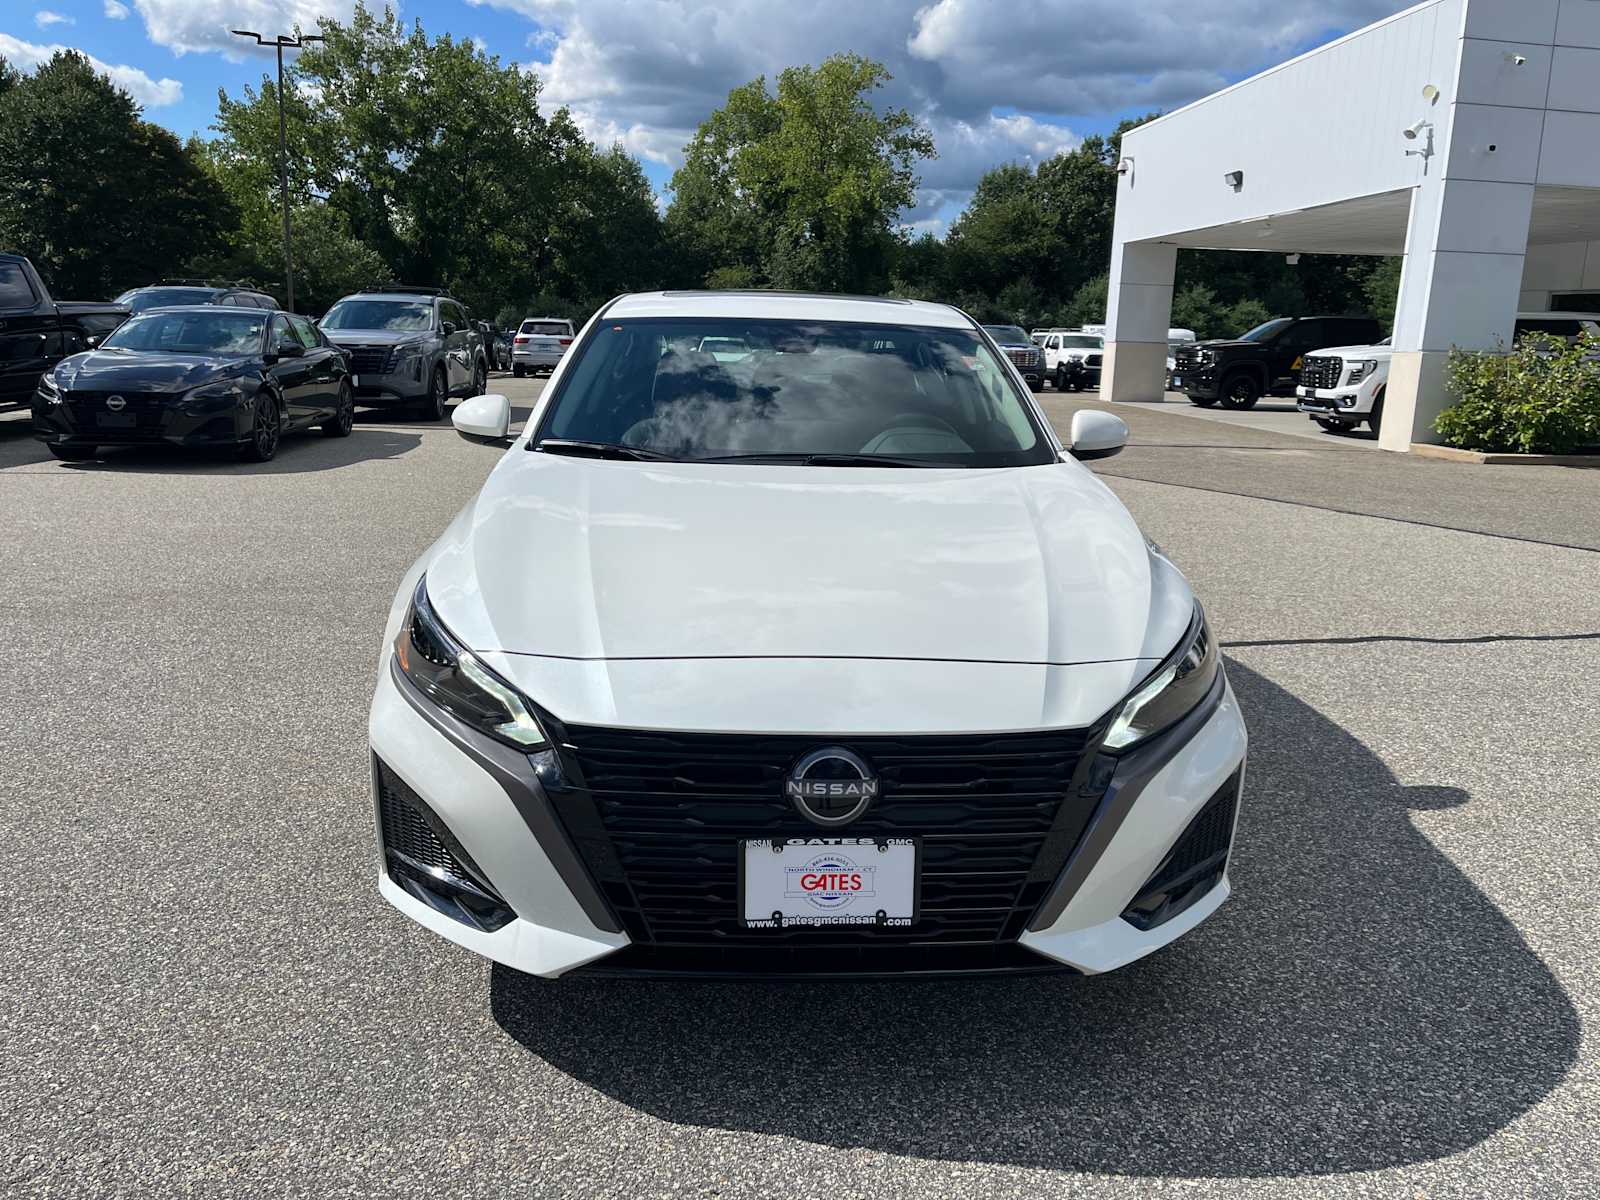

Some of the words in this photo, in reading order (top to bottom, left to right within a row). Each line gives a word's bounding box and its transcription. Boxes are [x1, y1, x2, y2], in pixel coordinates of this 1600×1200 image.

[788, 781, 876, 795] NISSAN
[745, 839, 772, 848] NISSAN
[786, 837, 875, 846] GATES
[886, 838, 913, 846] GMC
[800, 873, 862, 891] GATES
[782, 914, 876, 928] gatesgmcnissan
